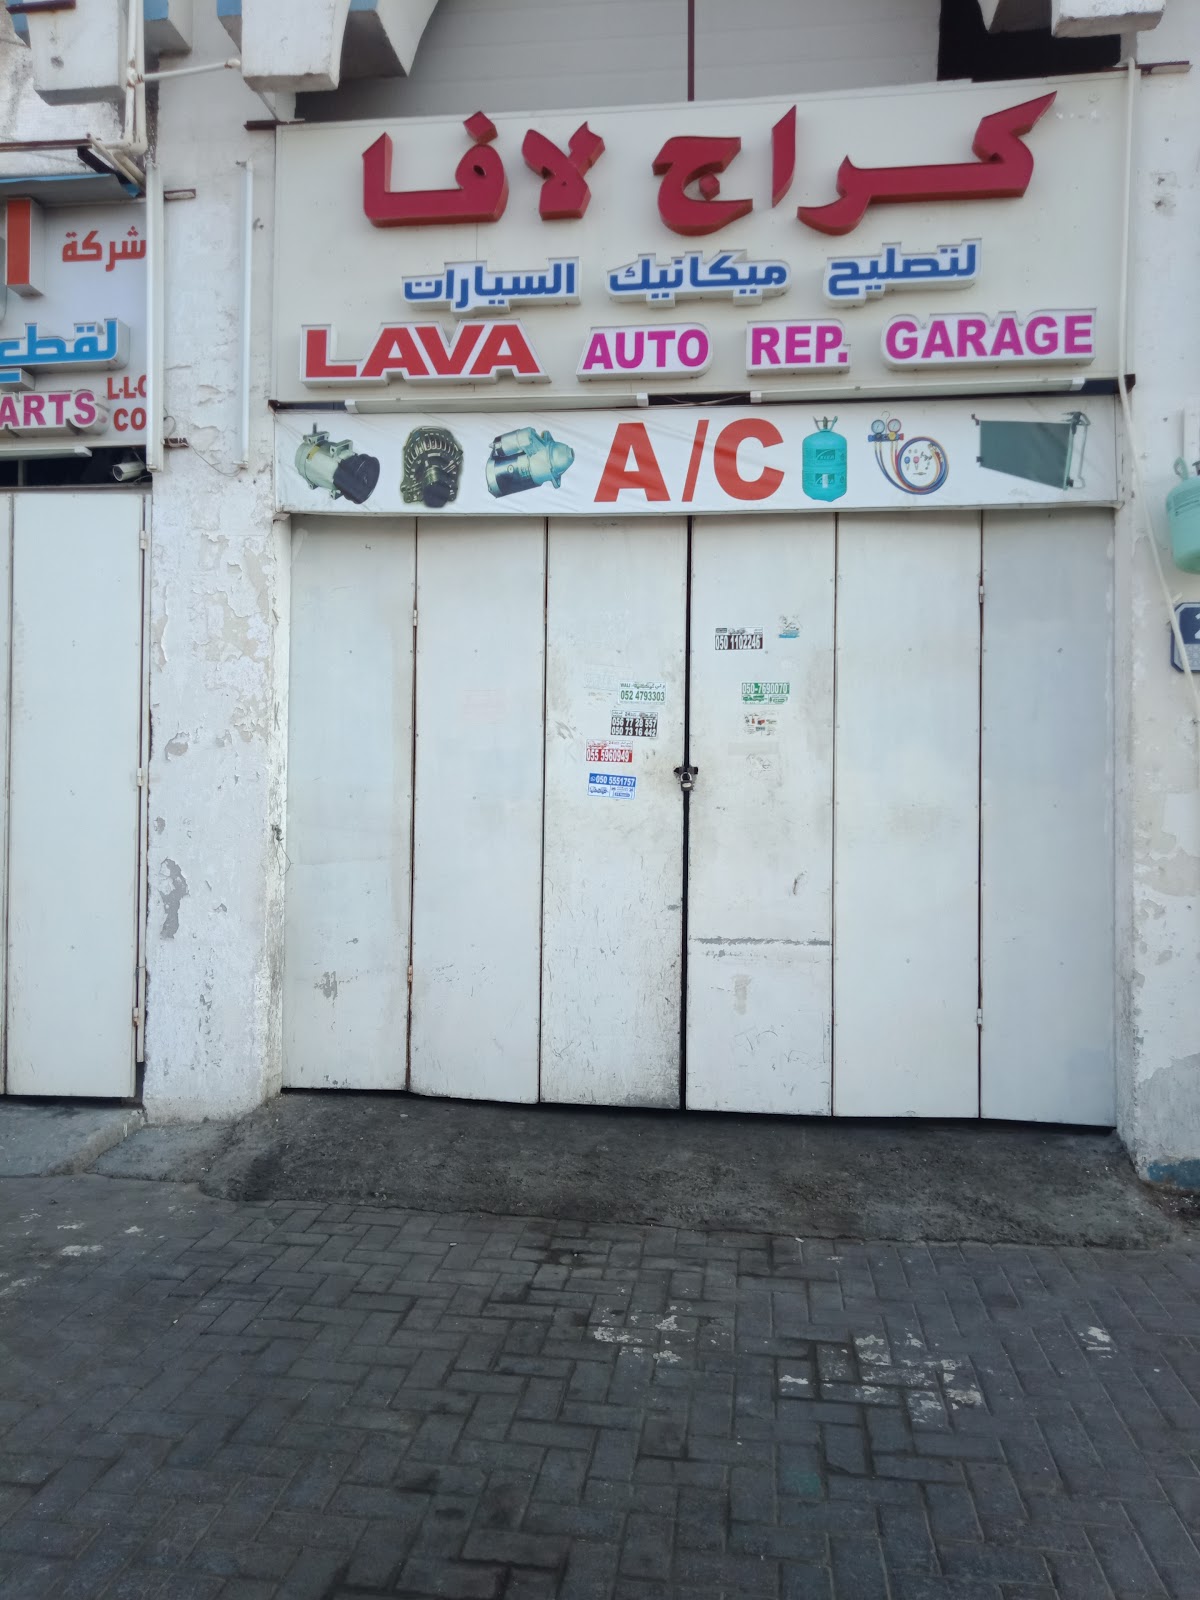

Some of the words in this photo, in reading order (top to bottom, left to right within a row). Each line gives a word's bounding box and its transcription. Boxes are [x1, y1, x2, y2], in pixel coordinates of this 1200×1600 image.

[362, 111, 605, 229] لافا
[652, 90, 1057, 237] كراج
[62, 225, 147, 272] شركة
[828, 243, 977, 297] لتصليح
[404, 263, 575, 309] السيارات
[609, 254, 787, 299] ميكانيك
[305, 324, 541, 378] LAVA
[582, 328, 709, 370] AUTO
[751, 325, 848, 366] REP.
[885, 314, 1093, 360] GARAGE
[594, 417, 784, 502] A/C
[715, 635, 729, 650] 050
[620, 690, 634, 700] 052
[635, 690, 665, 702] 4793303
[612, 717, 624, 726] 056
[625, 718, 634, 727] 77
[635, 719, 644, 727] 28
[645, 719, 657, 729] 557
[625, 727, 633, 736] 73
[635, 728, 643, 736] 16
[644, 728, 657, 737] 442
[586, 749, 599, 761] 055
